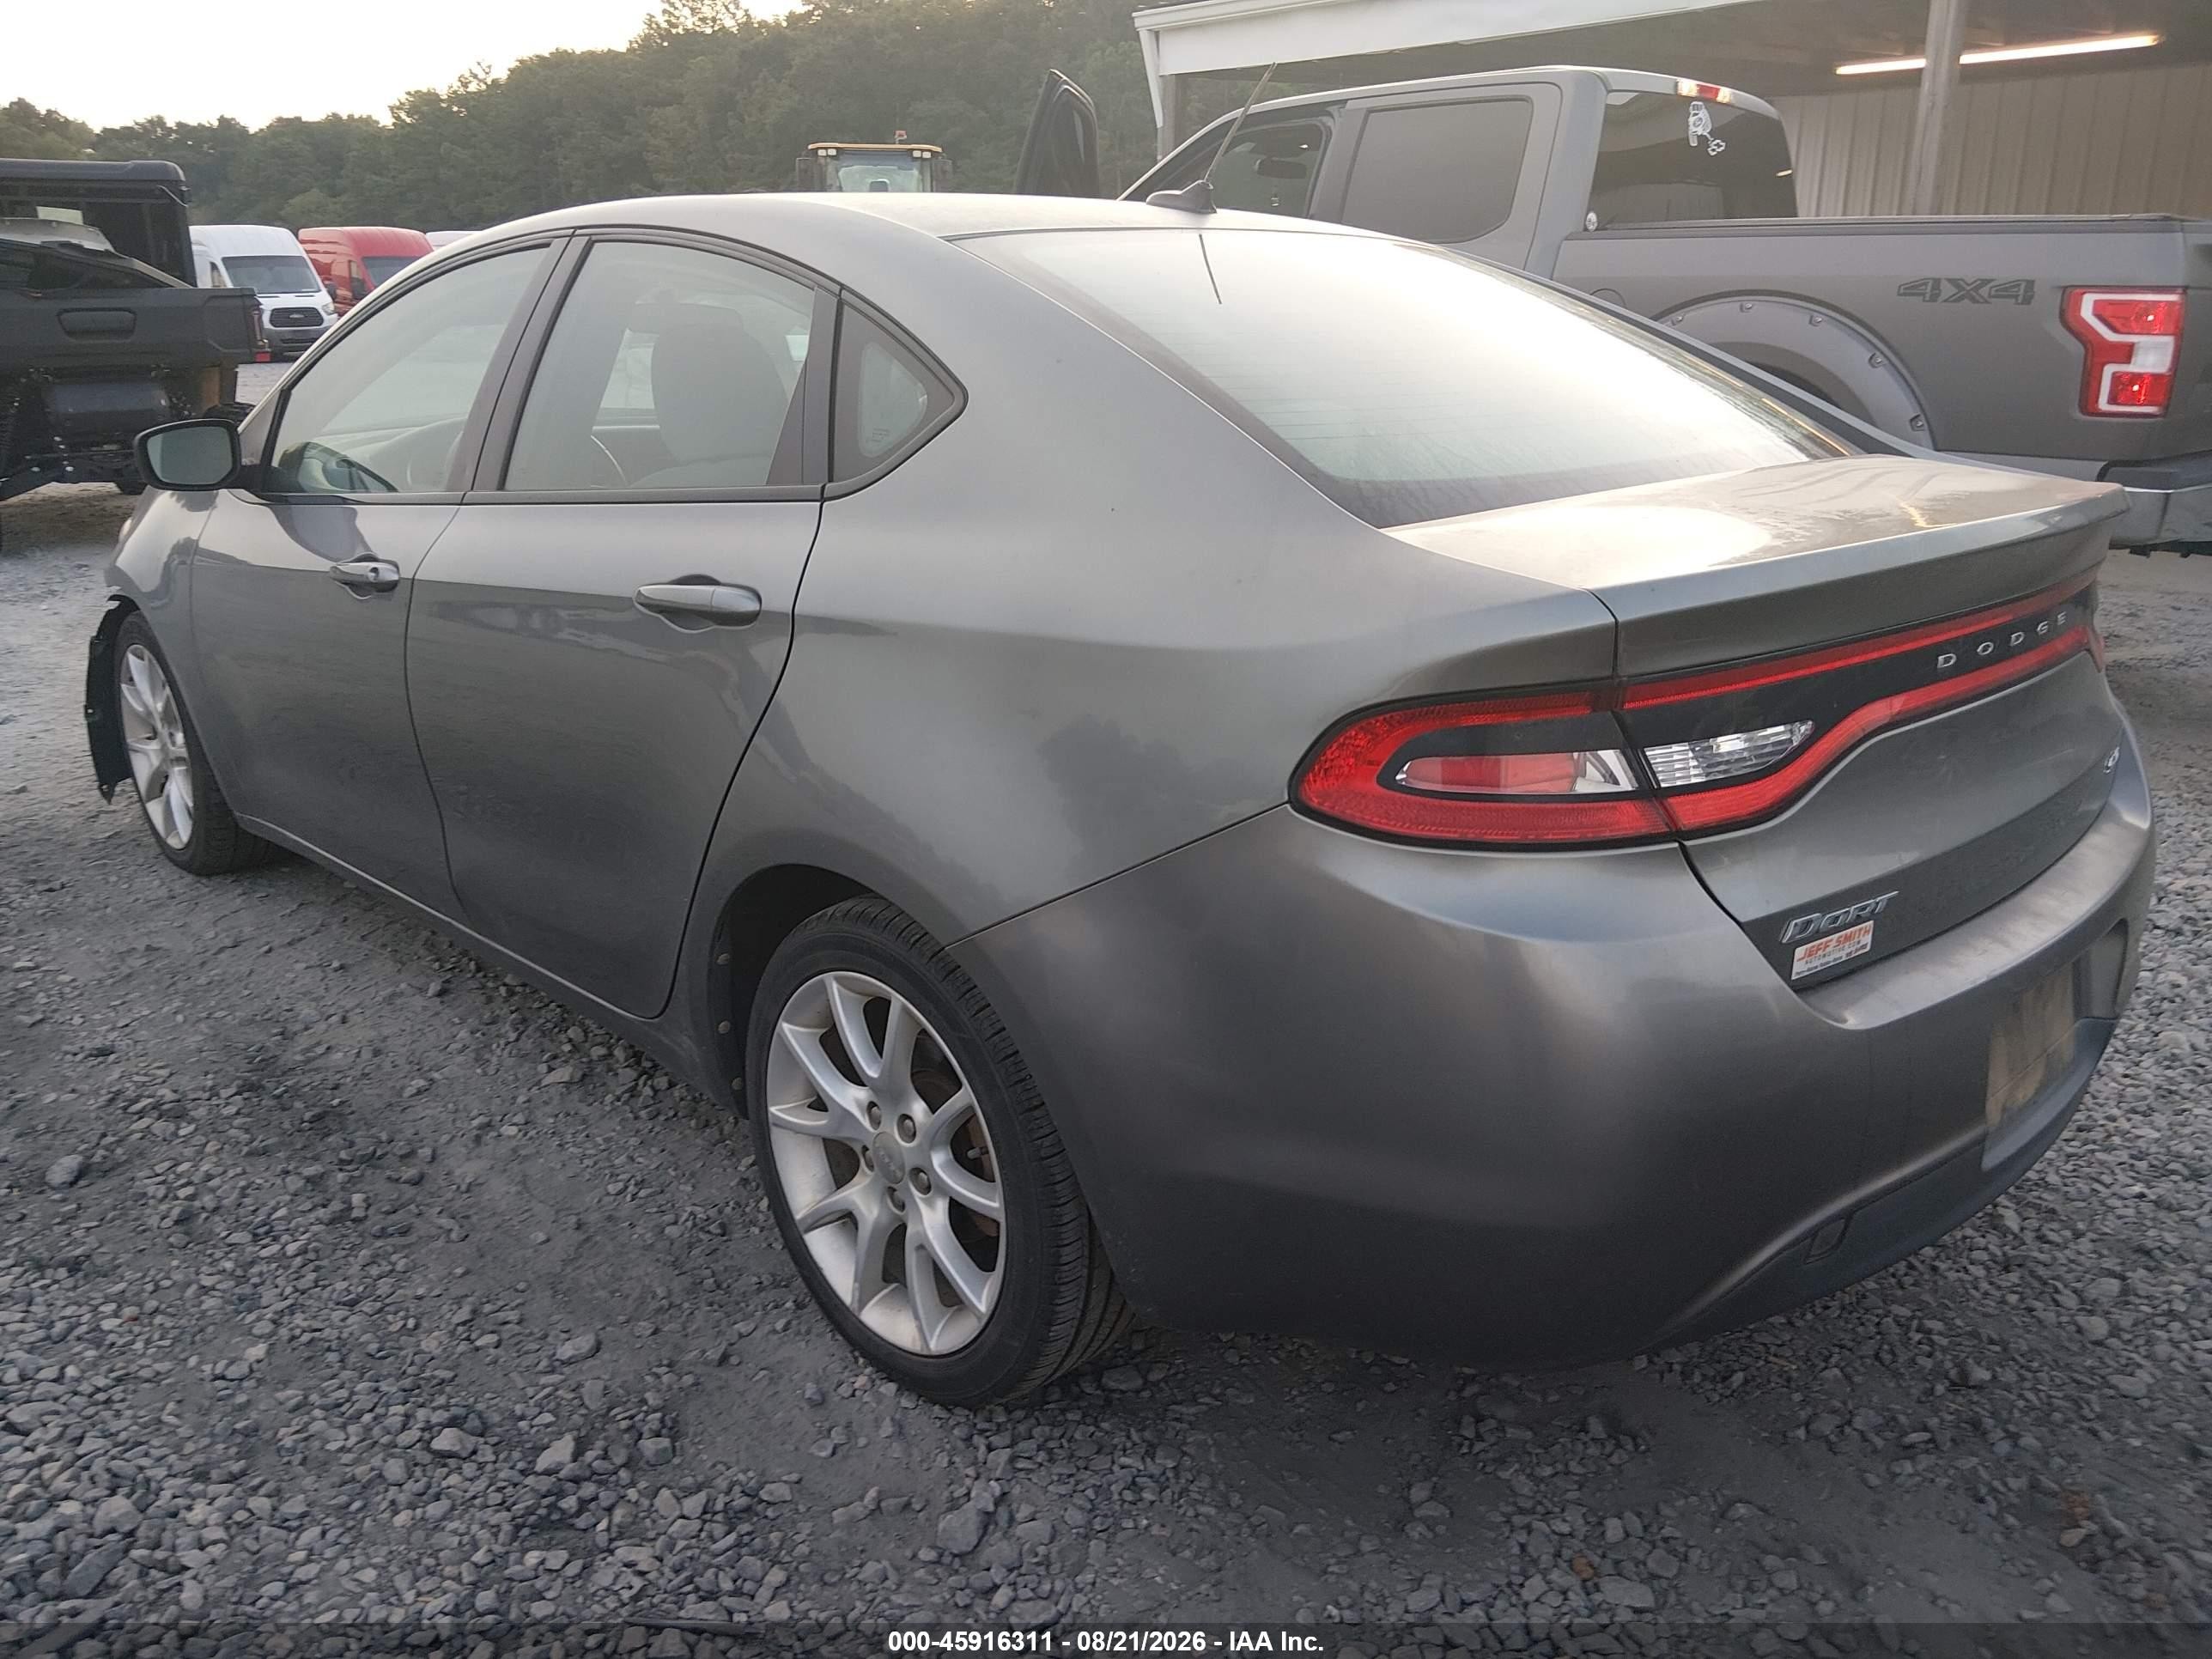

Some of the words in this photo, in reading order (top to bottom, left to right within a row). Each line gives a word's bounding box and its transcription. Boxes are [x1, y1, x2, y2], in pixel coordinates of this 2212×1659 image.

[1897, 277, 2035, 306] 4X4
[1937, 611, 2067, 669] DODGE
[1796, 939, 1834, 962] JEFF
[1832, 923, 1871, 948] SMITH
